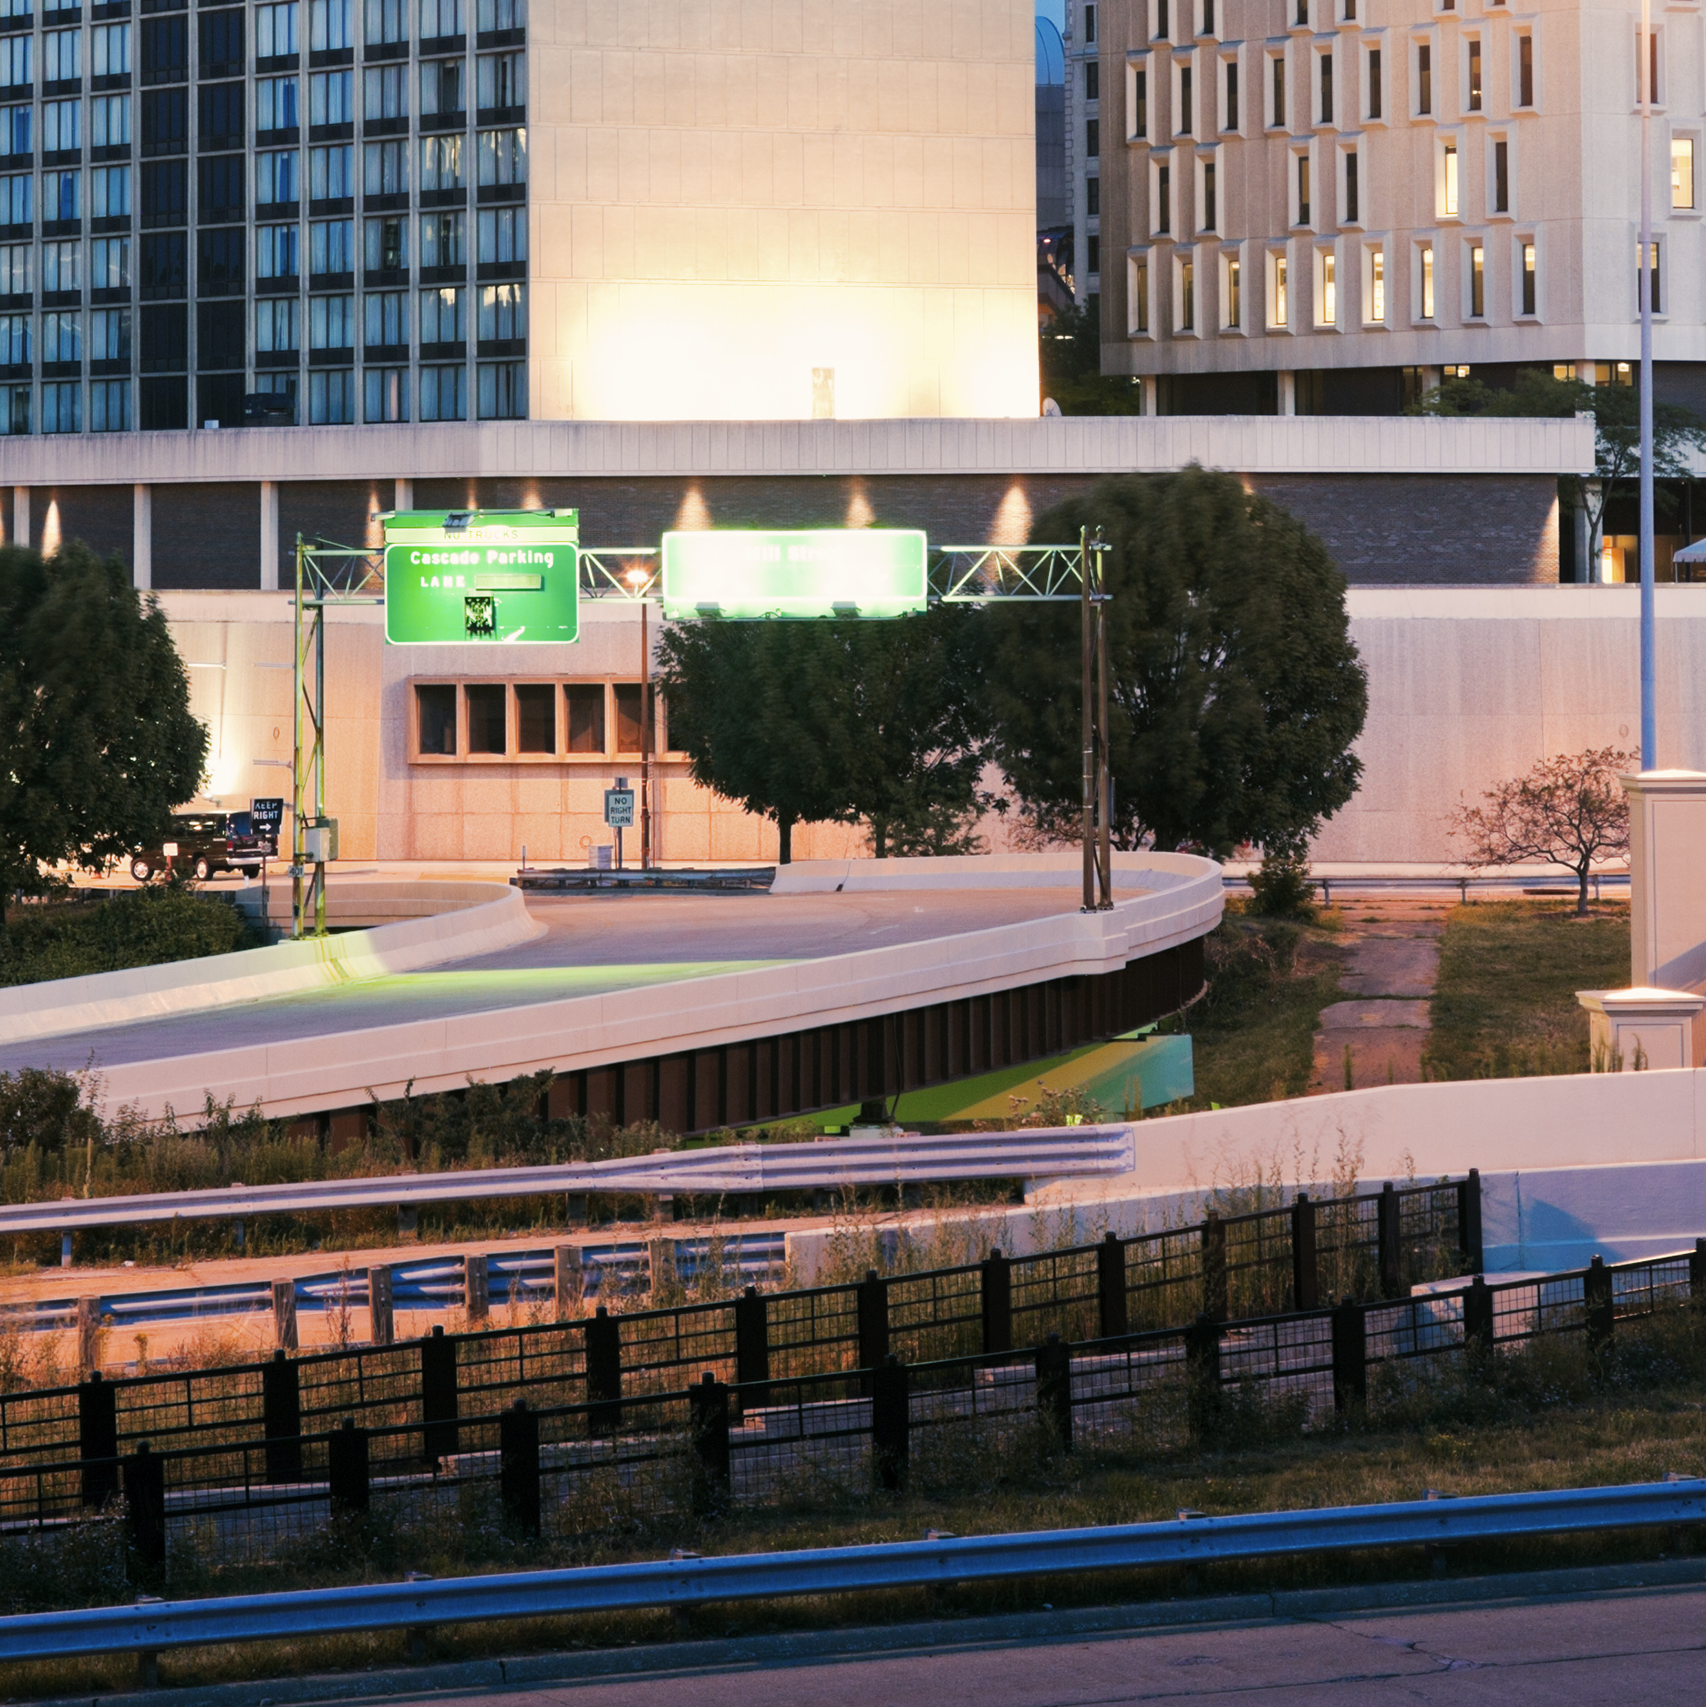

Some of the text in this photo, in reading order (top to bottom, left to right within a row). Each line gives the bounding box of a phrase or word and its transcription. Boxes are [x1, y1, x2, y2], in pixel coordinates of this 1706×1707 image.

[468, 530, 519, 540] TRUCKS
[410, 549, 554, 568] Cascade Parking
[420, 575, 466, 588] LANE
[255, 801, 277, 809] KEEP
[614, 797, 627, 805] NO
[610, 806, 631, 814] RIGHT
[253, 810, 278, 819] RIGHT
[611, 816, 630, 824] TURN
